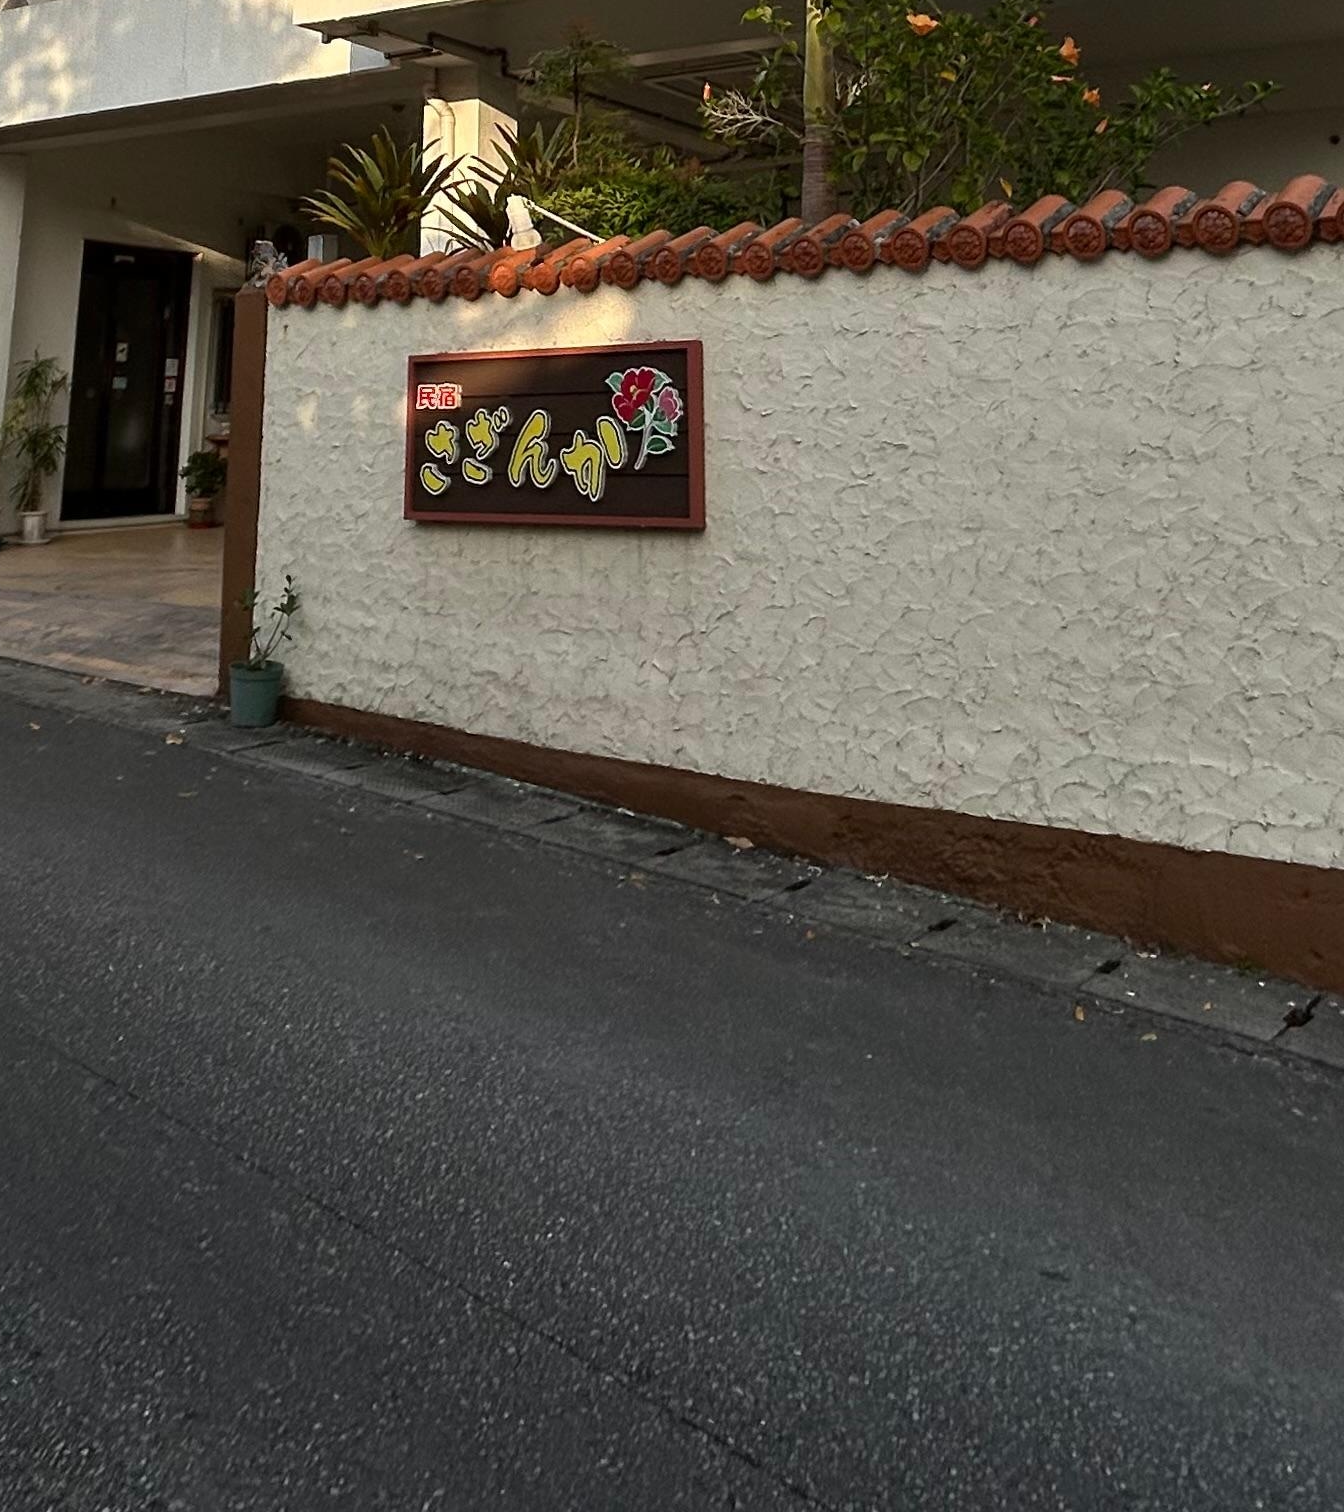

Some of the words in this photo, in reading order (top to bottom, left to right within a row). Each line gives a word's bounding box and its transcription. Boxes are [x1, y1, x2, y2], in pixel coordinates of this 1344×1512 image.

[416, 384, 462, 410] 民宿
[420, 407, 626, 502] さざんか
